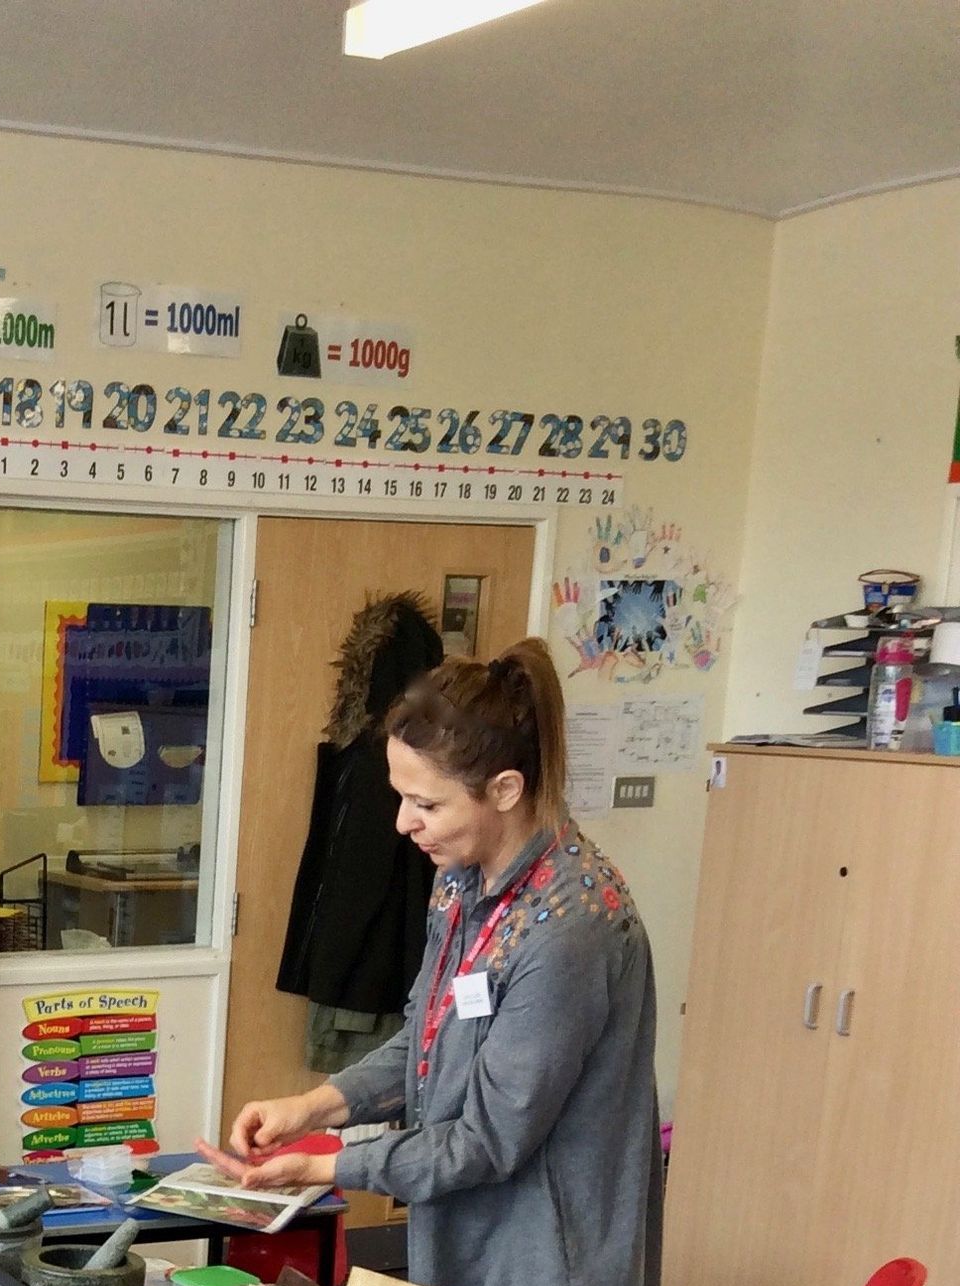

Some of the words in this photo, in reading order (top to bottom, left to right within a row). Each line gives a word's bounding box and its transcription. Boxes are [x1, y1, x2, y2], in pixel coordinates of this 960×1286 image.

[166, 302, 240, 338] 1000ml
[348, 339, 410, 378] 1000g
[50, 378, 94, 430] 19
[102, 382, 156, 432] 20
[163, 387, 211, 436] 21
[218, 391, 266, 440] 22
[276, 395, 325, 444] 23
[334, 400, 381, 449] 24
[384, 406, 431, 453] 25
[437, 408, 482, 454] 26
[488, 410, 534, 455] 27
[539, 414, 583, 458] 28
[588, 415, 631, 459] 29
[638, 418, 687, 462] 30
[1, 457, 6, 474] 1
[31, 459, 39, 475] 2
[60, 461, 68, 477] 3
[89, 462, 96, 478] 4
[117, 464, 124, 480] 5
[145, 465, 152, 481] 6
[172, 468, 179, 484] 7
[200, 469, 207, 485] 8
[228, 471, 235, 487] 9
[252, 472, 265, 488] 10
[279, 474, 289, 489] 11
[305, 475, 317, 491] 12
[332, 478, 345, 493] 13
[359, 479, 371, 494] 14
[384, 480, 397, 495] 15
[410, 481, 422, 496] 16
[435, 482, 447, 497] 17
[459, 483, 471, 499] 18
[485, 484, 497, 499] 19
[508, 485, 522, 500] 20
[533, 486, 545, 501] 21
[557, 487, 569, 503] 22
[579, 489, 591, 504] 23
[602, 490, 614, 504] 24
[36, 997, 74, 1016] Parts
[79, 997, 92, 1009] of
[98, 995, 148, 1010] Speech
[38, 1024, 71, 1036] Nouns
[32, 1044, 76, 1056] Pronouns
[37, 1066, 67, 1078] Verbs
[32, 1111, 71, 1123] Articles
[31, 1133, 70, 1145] Adverbs
